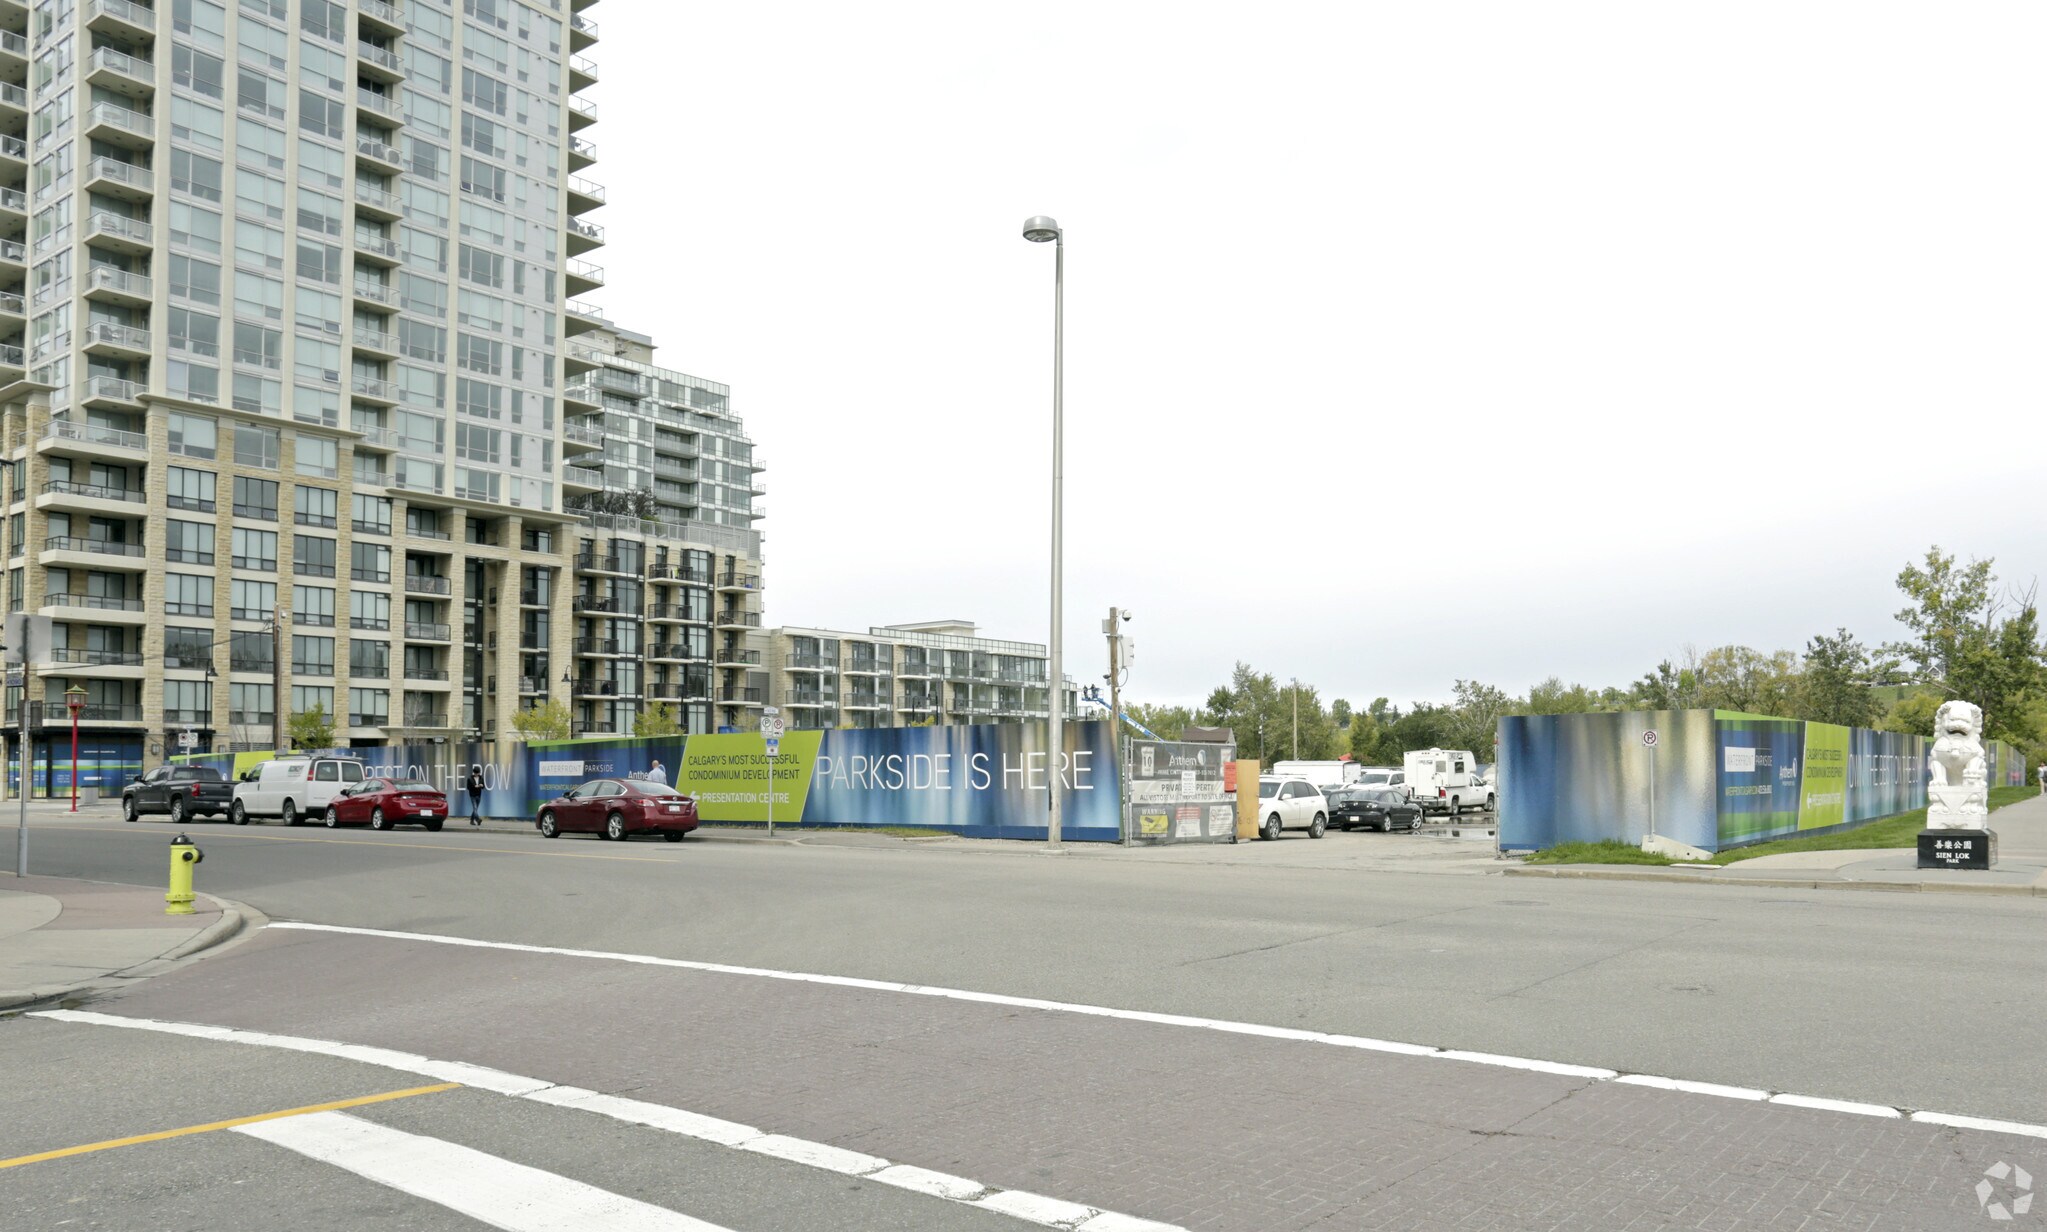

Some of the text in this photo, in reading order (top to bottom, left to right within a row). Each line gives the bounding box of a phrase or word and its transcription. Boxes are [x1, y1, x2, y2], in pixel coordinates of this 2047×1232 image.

[688, 755, 727, 766] CALGARY'S
[728, 754, 749, 765] MOST
[1168, 755, 1197, 767] Anthem
[584, 763, 614, 773] PARKSIDE
[815, 750, 1094, 791] PARKSIDE IS HERE
[434, 764, 467, 791] THE
[627, 770, 649, 780] Anthe
[688, 770, 741, 780] CONDOMINIUM
[702, 792, 757, 804] PRESENTATION
